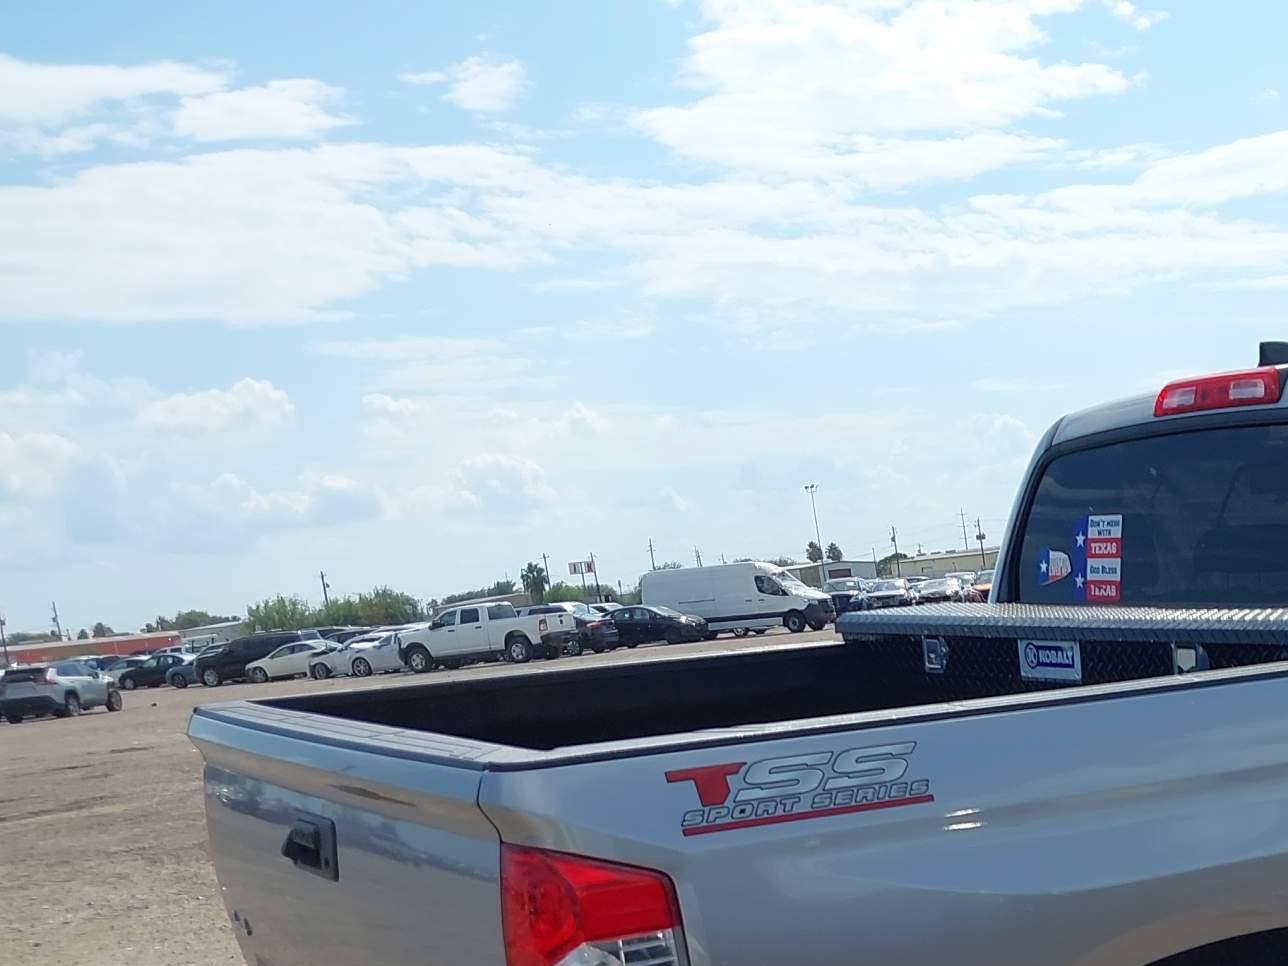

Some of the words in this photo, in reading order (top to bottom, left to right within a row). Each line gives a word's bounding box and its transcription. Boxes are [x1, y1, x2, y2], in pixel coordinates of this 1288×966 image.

[1091, 542, 1117, 554] TEXAS
[1090, 584, 1116, 597] TEXAS
[1038, 649, 1073, 665] KOBALT
[664, 740, 917, 807] TSS
[681, 797, 801, 827] SPORT
[811, 779, 930, 809] SERIES
